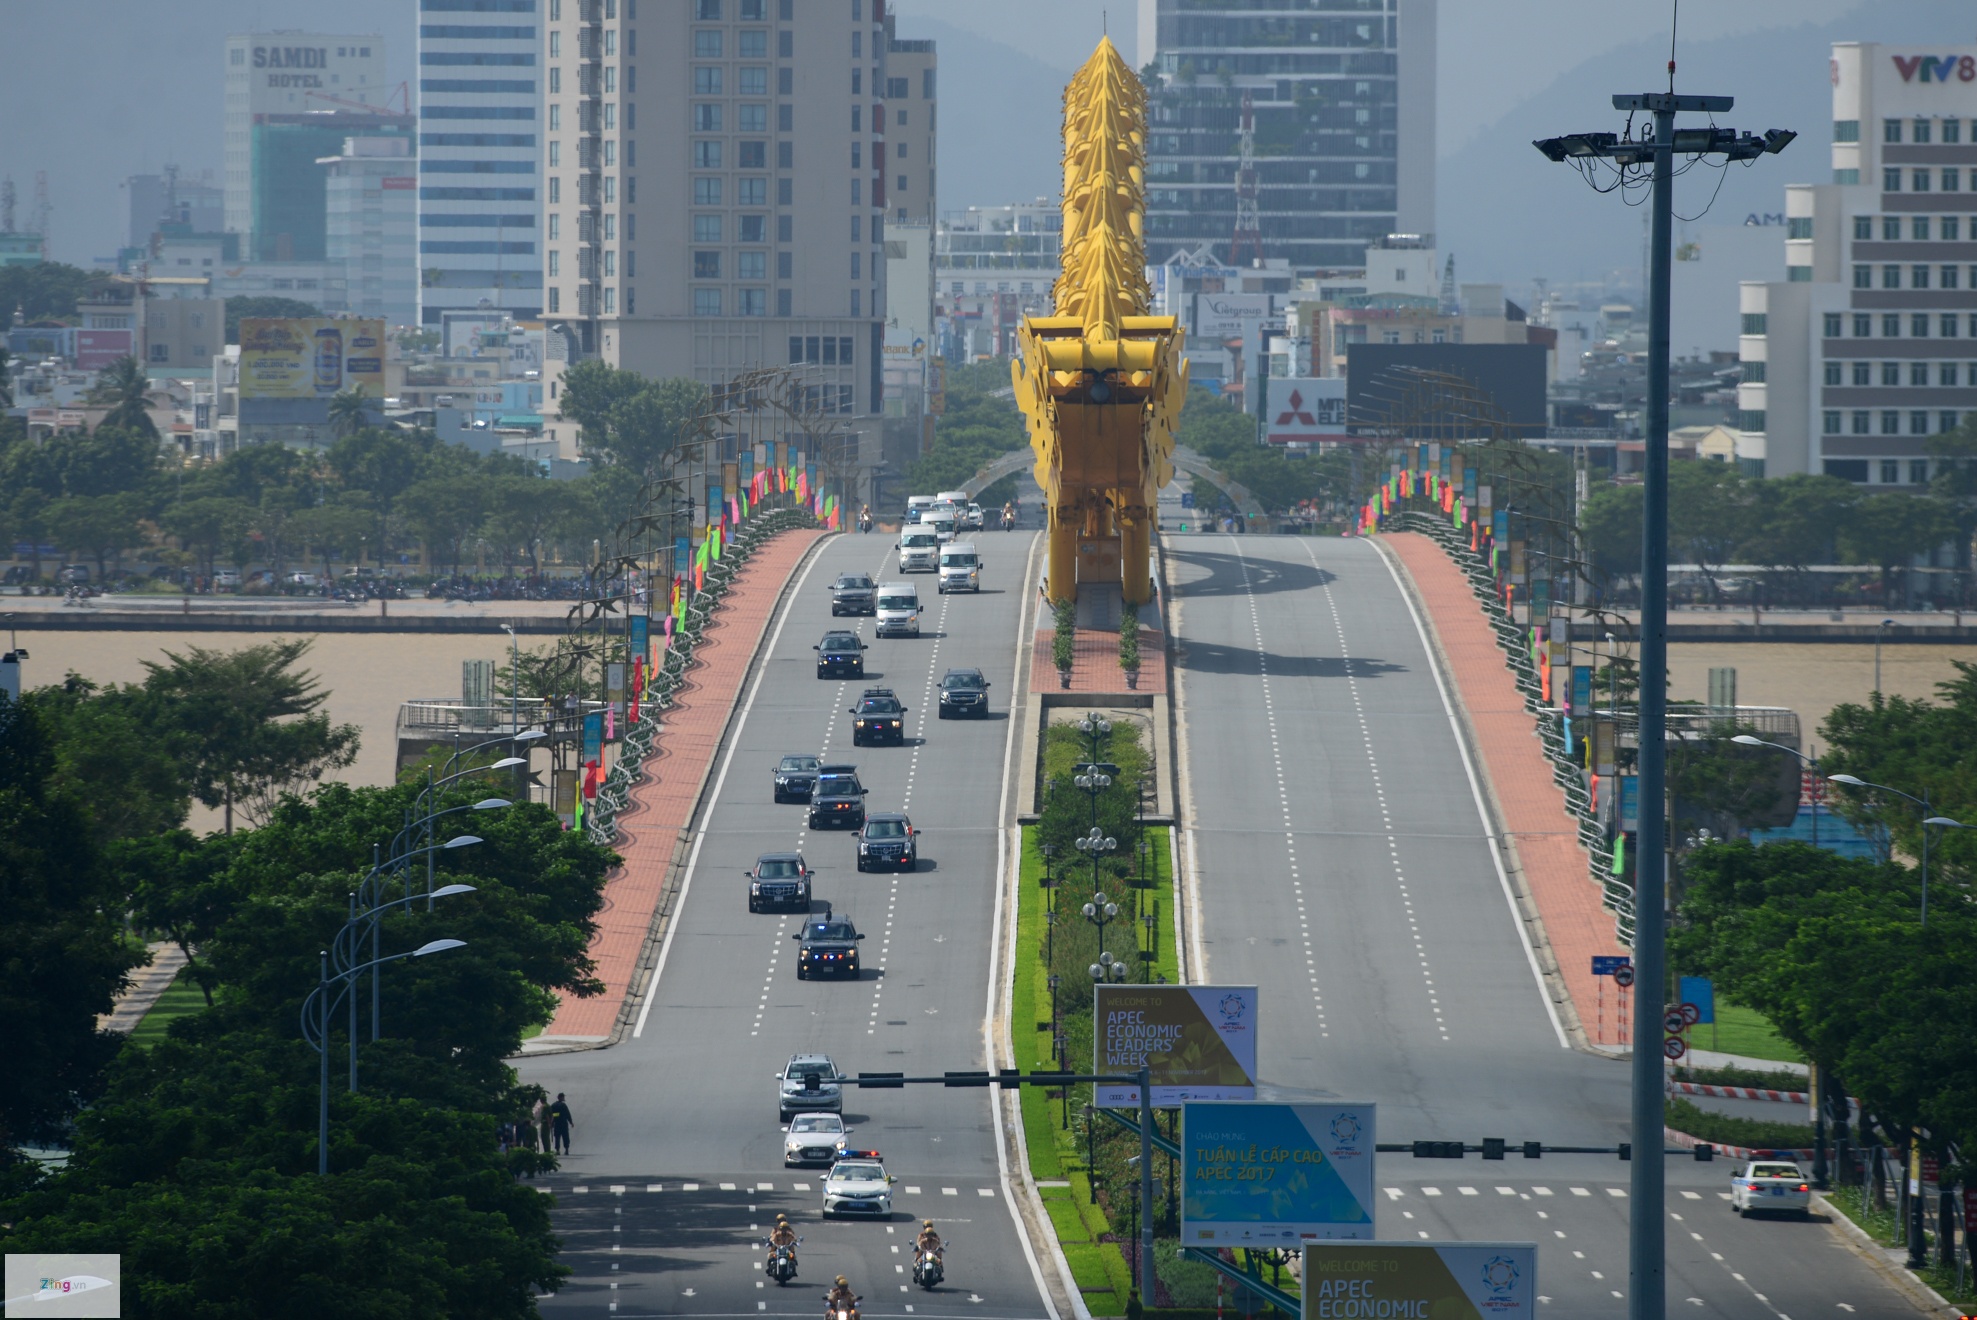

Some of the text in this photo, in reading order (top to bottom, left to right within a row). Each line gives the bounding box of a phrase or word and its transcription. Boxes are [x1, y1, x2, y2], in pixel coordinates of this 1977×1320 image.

[253, 47, 327, 68] SAMDI
[1891, 55, 1976, 82] VTV8
[268, 74, 324, 88] HOTEL
[1744, 213, 1788, 226] AM
[1173, 267, 1238, 278] VinaPhone
[1107, 997, 1162, 1006] WELCOME TO
[1107, 1011, 1145, 1024] APEC
[1107, 1024, 1182, 1038] ECONOMIC
[1107, 1052, 1149, 1066] WEEK
[1261, 1145, 1290, 1163] CẤP
[1293, 1150, 1323, 1163] CAO
[1195, 1167, 1276, 1181] APEC 2017
[1319, 1260, 1398, 1272] WELCOME TO
[1319, 1280, 1374, 1298] APEC
[1319, 1300, 1428, 1318] ECONOMIC
